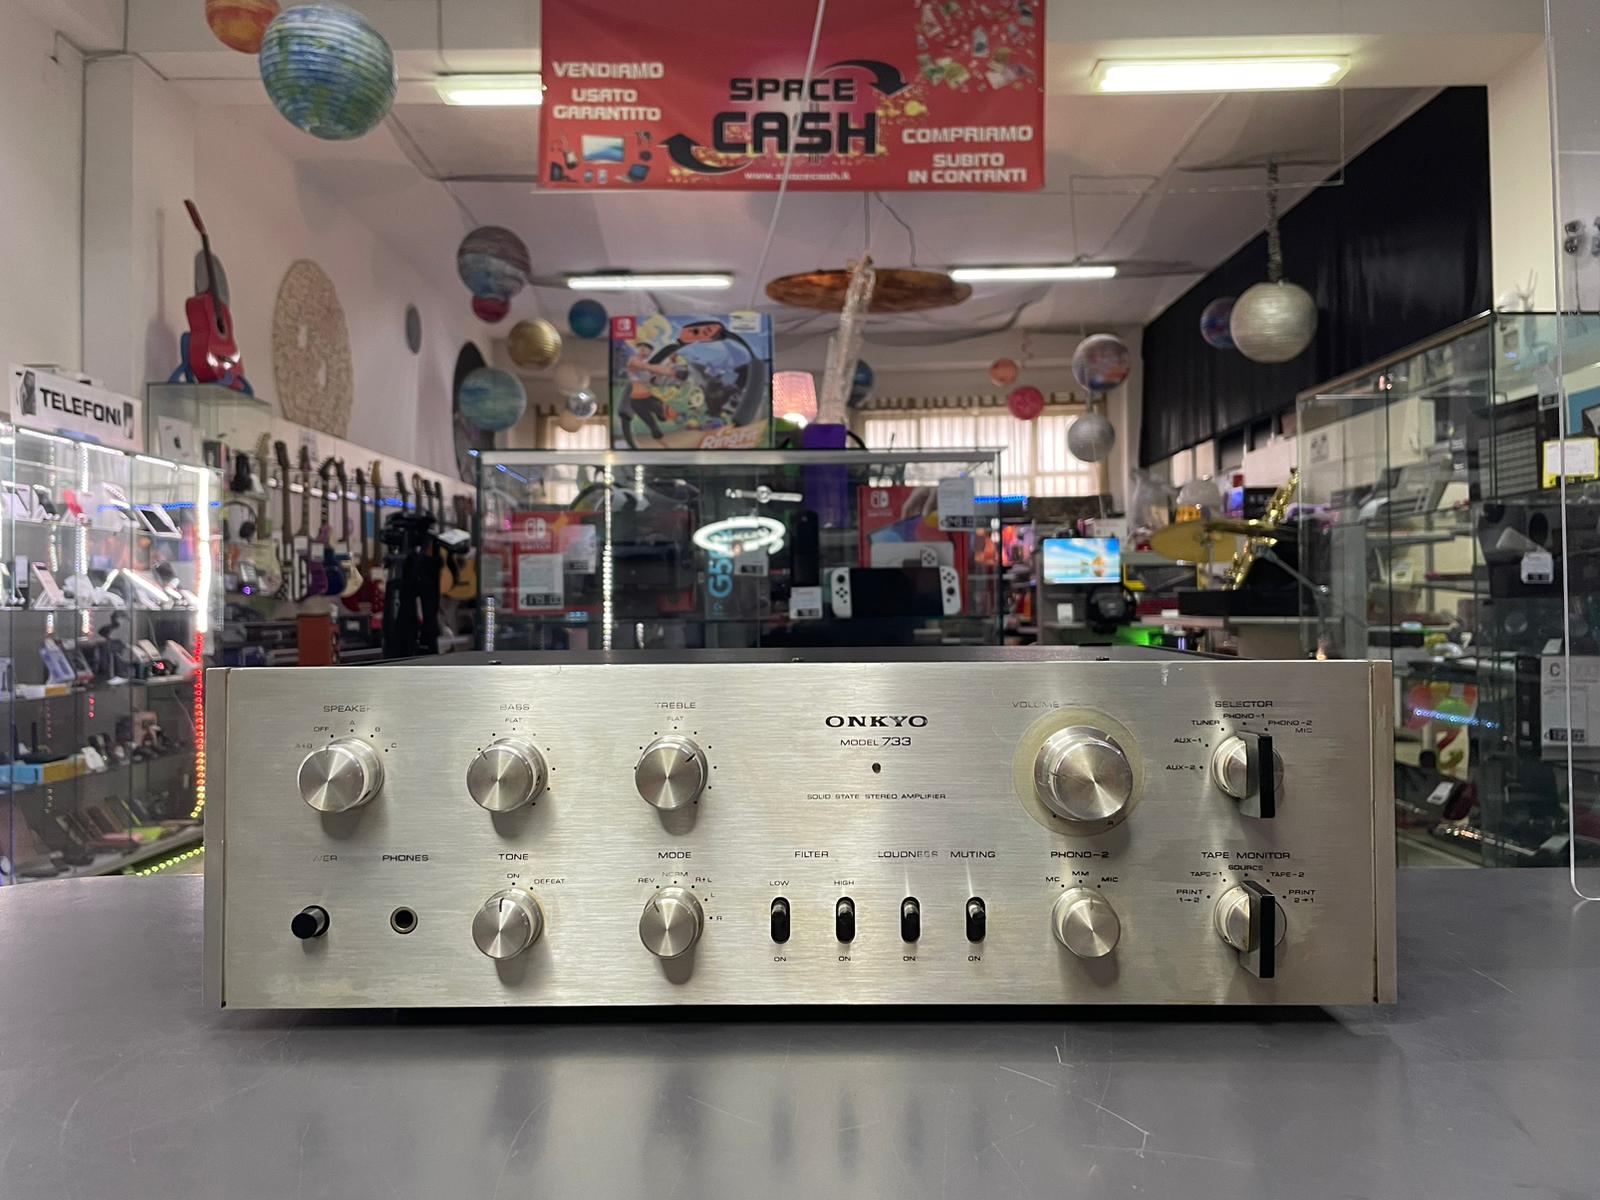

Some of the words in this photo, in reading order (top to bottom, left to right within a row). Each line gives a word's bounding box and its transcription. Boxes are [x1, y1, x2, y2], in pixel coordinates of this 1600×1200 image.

[552, 61, 664, 79] VENDIAMO
[729, 78, 855, 101] SPACE
[571, 87, 638, 103] USATO
[552, 105, 662, 121] GARANTITO
[713, 111, 877, 154] CASH
[902, 125, 1034, 144] COMPRIAMO
[932, 152, 1005, 168] SUBITO
[907, 169, 928, 184] IN
[931, 167, 1028, 184] CONTANTI
[40, 387, 122, 427] TELEFONI
[499, 703, 530, 711] BASS
[654, 701, 697, 709] TREBLE
[1011, 701, 1060, 709] VOLUME
[1214, 700, 1273, 708] SELECTOR
[825, 715, 928, 728] ONKYO
[880, 736, 912, 747] 733
[382, 854, 430, 862] PHONES
[498, 853, 529, 861] TONE
[657, 851, 692, 859] MODE
[794, 850, 829, 858] FILTER
[950, 850, 996, 858] MUTING
[1050, 851, 1110, 859] PHONO-2
[1200, 851, 1229, 859] TAPE
[1236, 851, 1290, 859] MONITOR
[1289, 888, 1316, 896] PRINT
